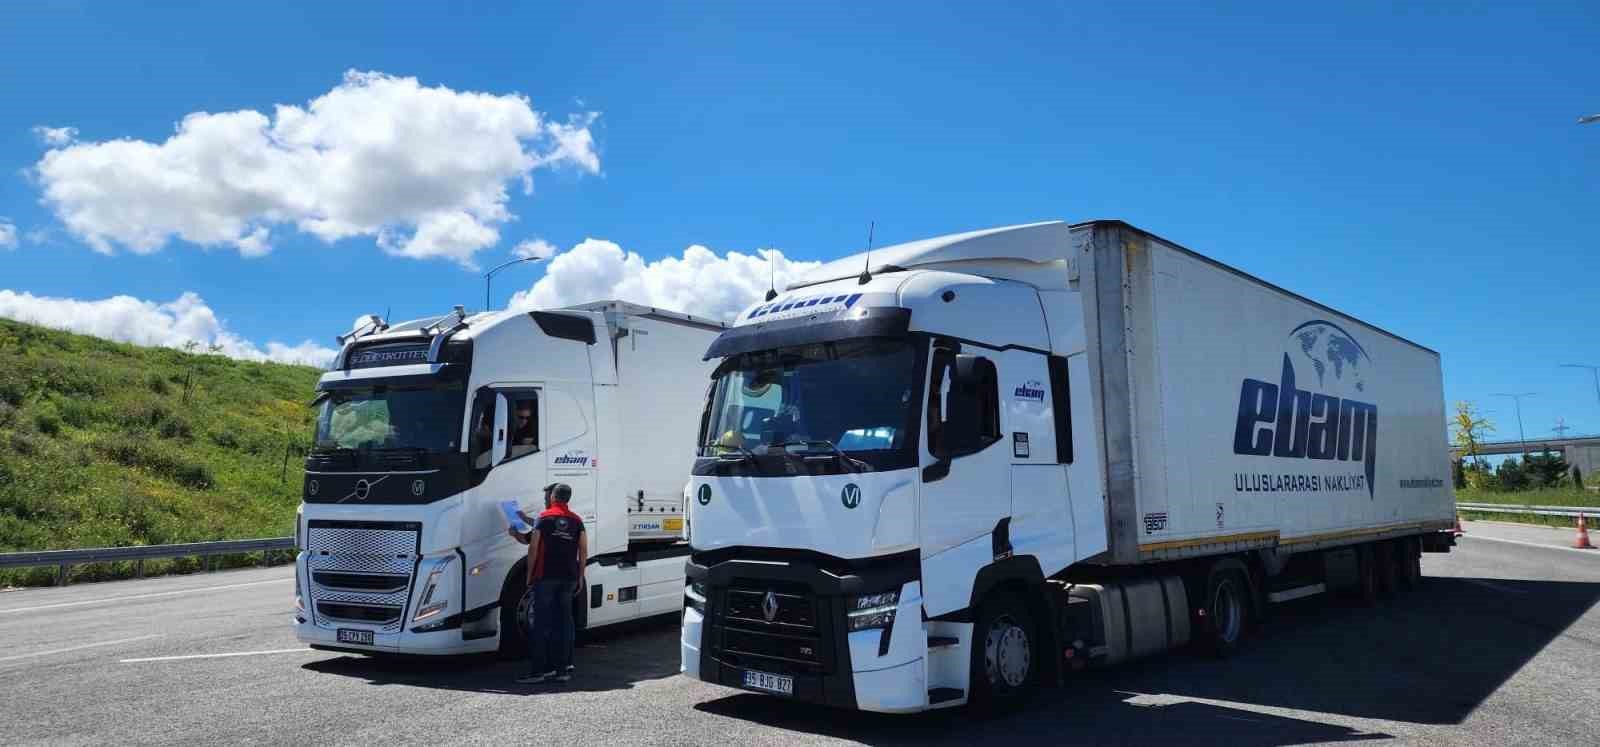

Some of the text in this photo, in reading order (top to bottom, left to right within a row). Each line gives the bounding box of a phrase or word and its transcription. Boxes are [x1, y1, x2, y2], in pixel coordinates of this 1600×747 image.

[1015, 383, 1045, 403] ebam
[1233, 352, 1378, 500] ebam
[554, 454, 588, 467] ebam
[1234, 472, 1322, 492] ULUSLARARASI
